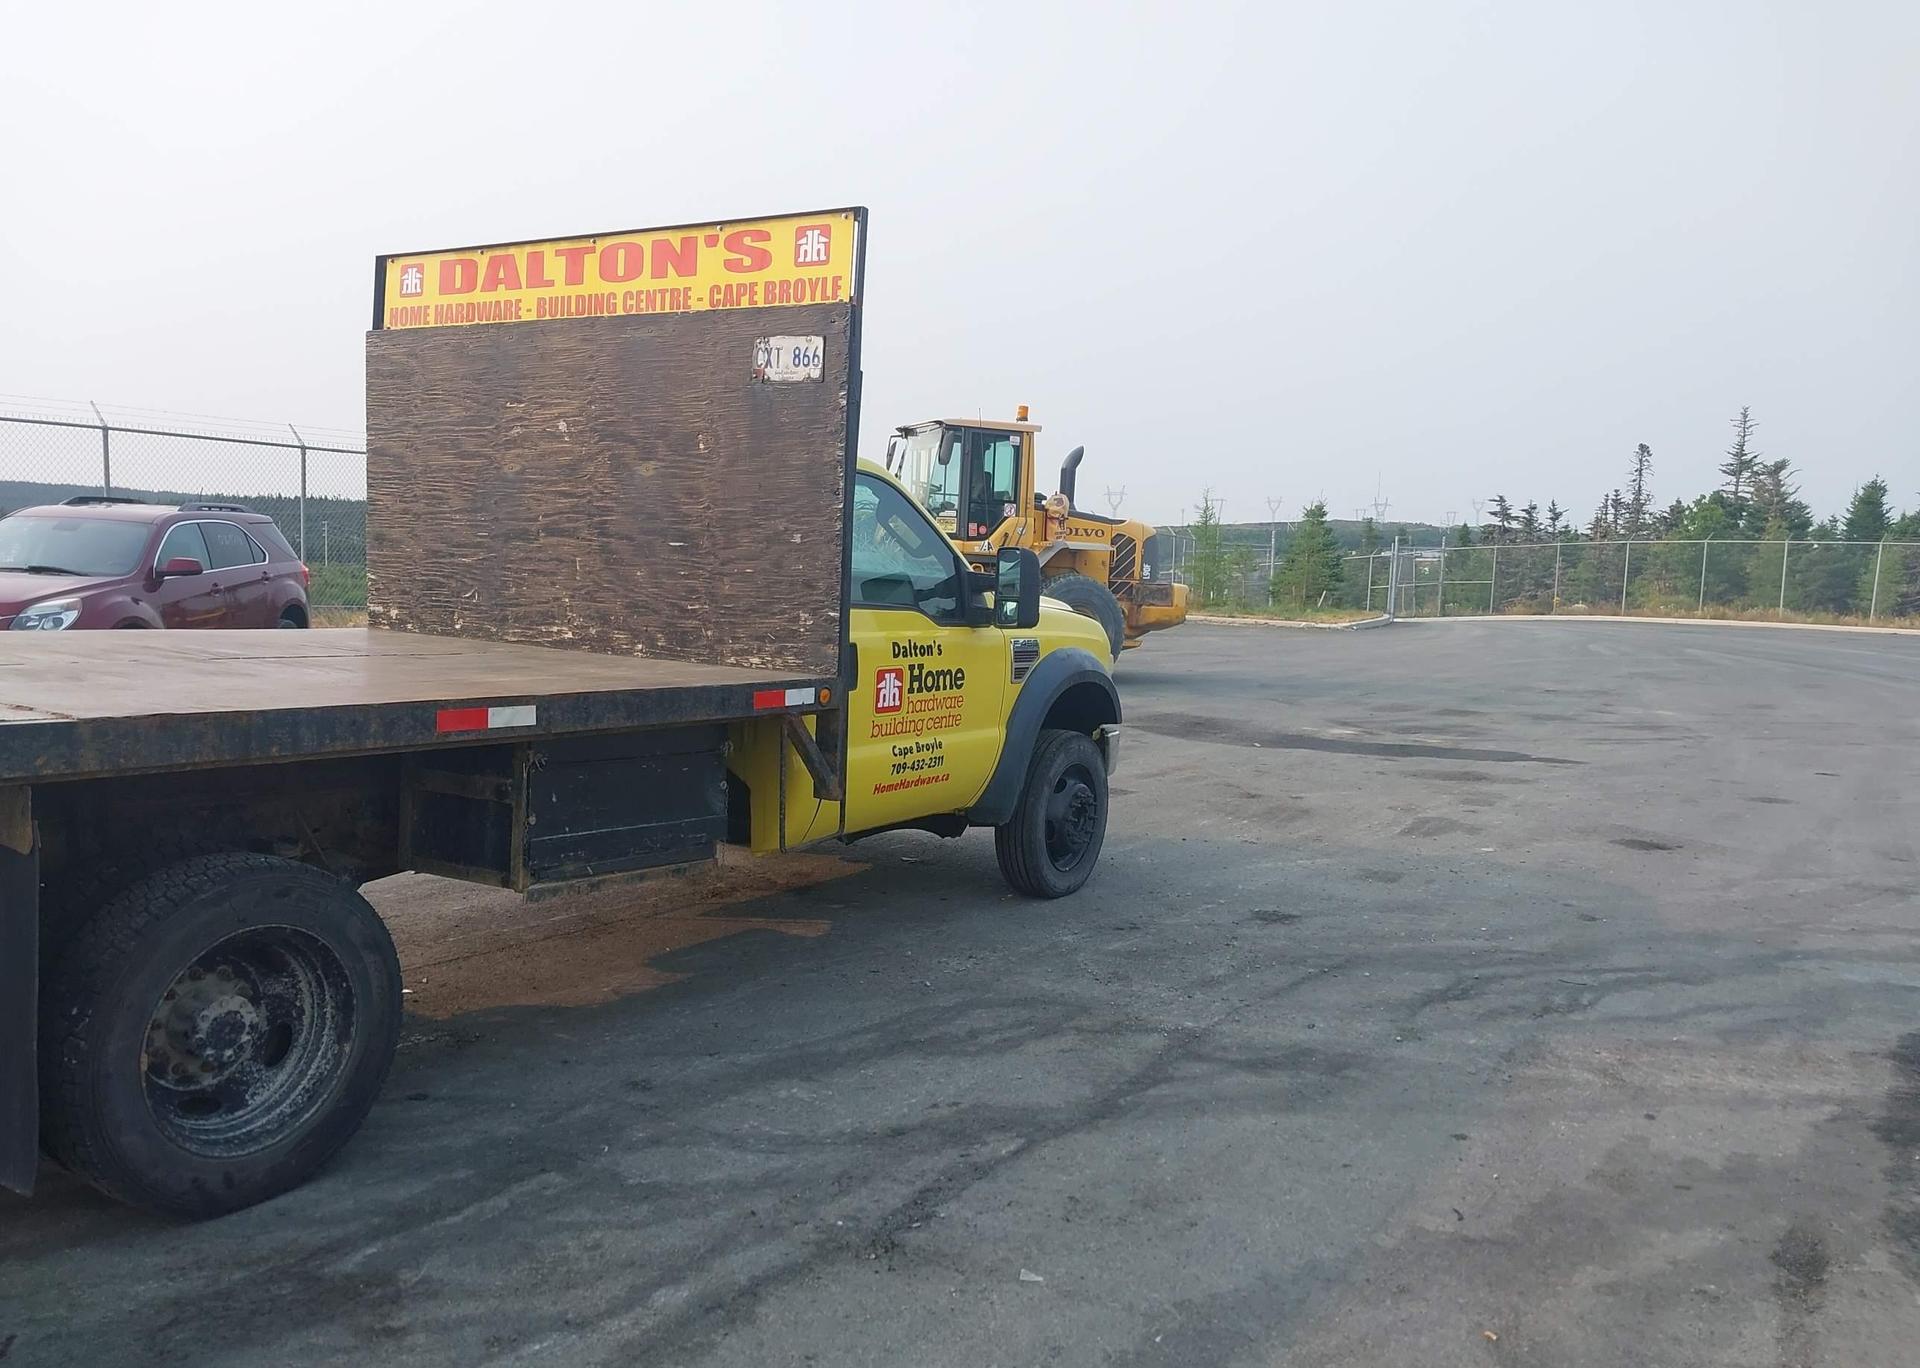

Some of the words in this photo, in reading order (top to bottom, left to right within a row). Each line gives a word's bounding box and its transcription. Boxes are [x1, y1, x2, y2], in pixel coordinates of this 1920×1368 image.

[439, 229, 773, 296] DALTON'S
[389, 305, 430, 328] HOME
[434, 299, 522, 326] HARDWARE
[536, 291, 618, 319] BUILDING
[622, 286, 692, 314] CENTRE
[709, 282, 759, 309] CAPE
[763, 275, 843, 305] BROYLE
[792, 346, 821, 368] 866
[1064, 526, 1105, 538] OLVO
[892, 639, 943, 659] Dalton's
[907, 664, 965, 694] Home
[906, 694, 964, 714] hardware
[870, 717, 925, 738] building
[926, 711, 962, 731] centre
[892, 745, 914, 759] Cape
[915, 737, 943, 754] Broyle
[891, 755, 944, 776] 709-432-2311
[873, 773, 950, 795] HomeHardware.ca
